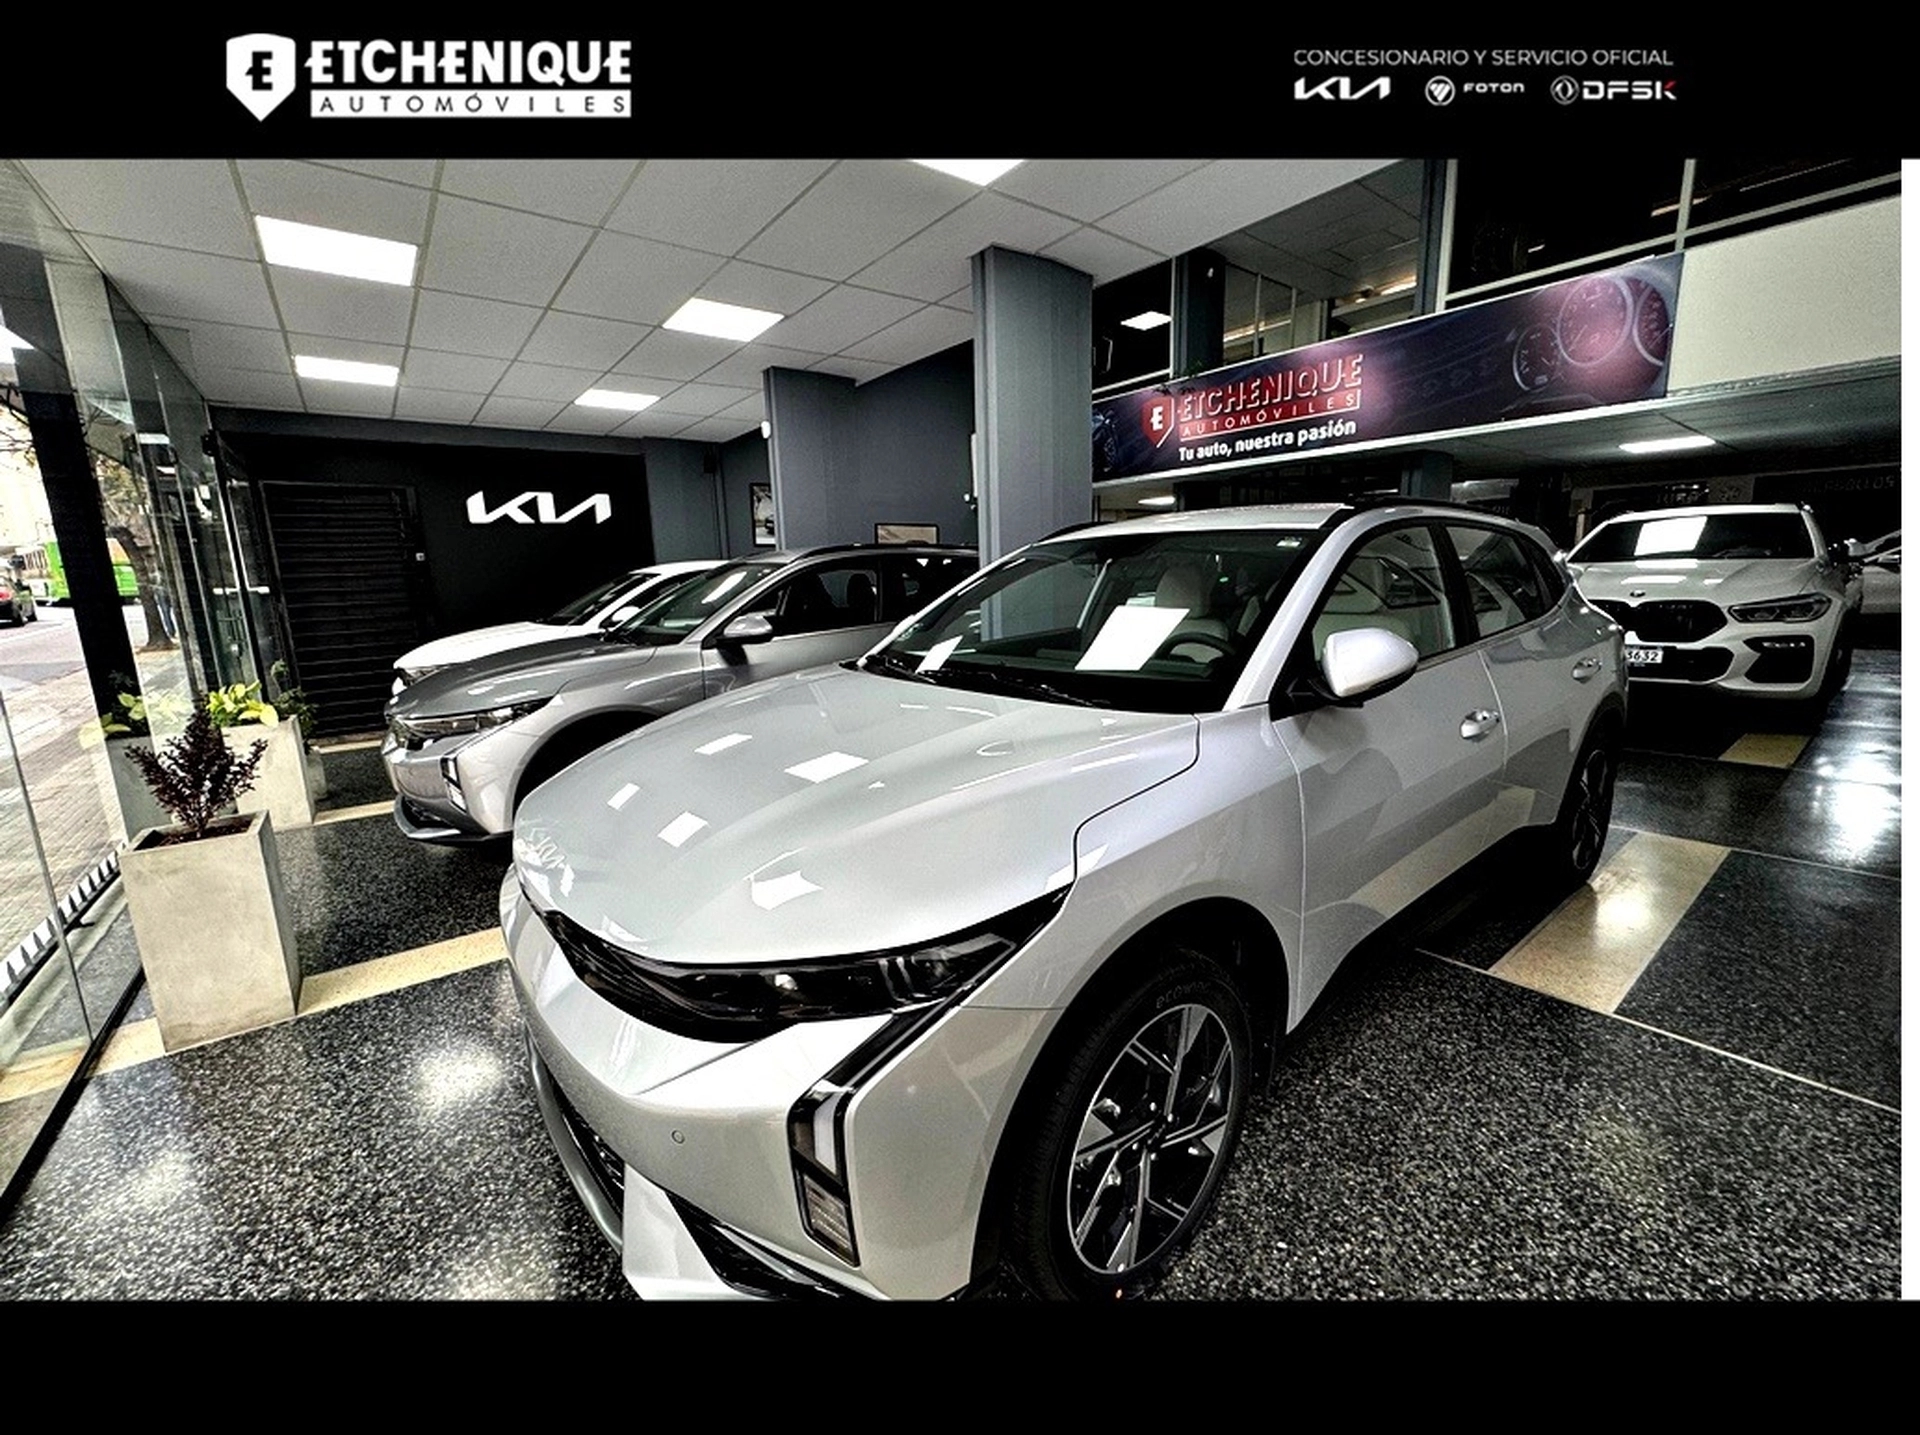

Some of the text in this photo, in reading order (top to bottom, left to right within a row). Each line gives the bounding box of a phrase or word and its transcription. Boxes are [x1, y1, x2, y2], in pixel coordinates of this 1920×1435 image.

[1177, 354, 1363, 422] ETCHENIQUE
[1182, 392, 1356, 437] AUTOMÓVILES
[1179, 419, 1356, 461] Tu auto, nuestra pasión
[466, 490, 612, 525] KIA
